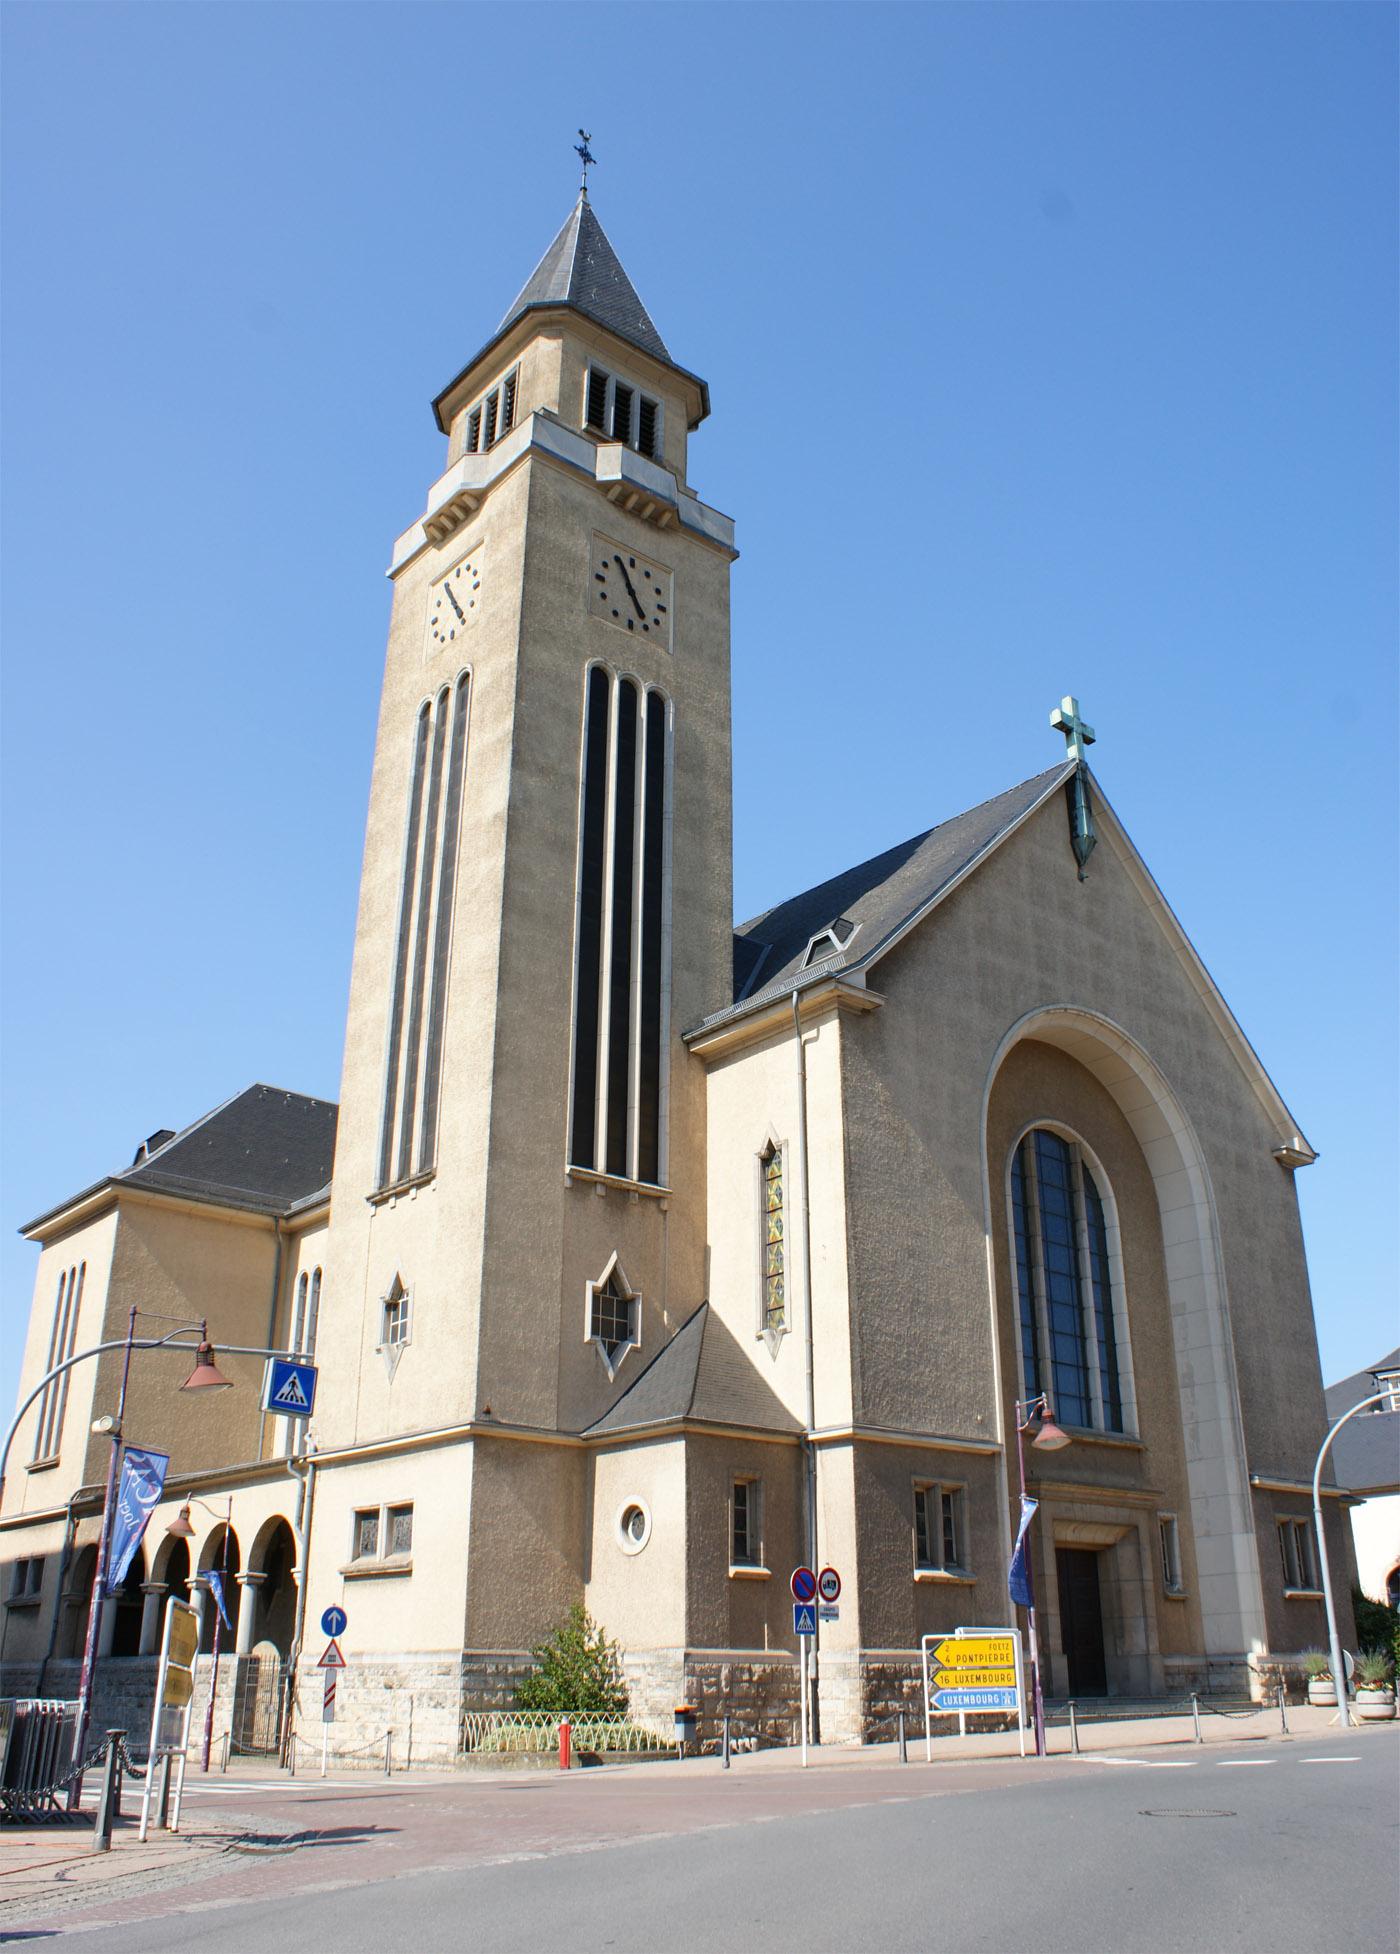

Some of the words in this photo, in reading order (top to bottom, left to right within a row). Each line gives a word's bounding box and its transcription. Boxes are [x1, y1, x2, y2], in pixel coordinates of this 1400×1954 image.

[989, 1643, 1009, 1651] FOETZ
[945, 1655, 950, 1663] 4
[956, 1653, 1010, 1663] PONTPIERRE
[940, 1675, 950, 1684] 16
[955, 1672, 1012, 1684] LUXEMBOURG
[943, 1694, 1000, 1706] LUXEMBOURG
